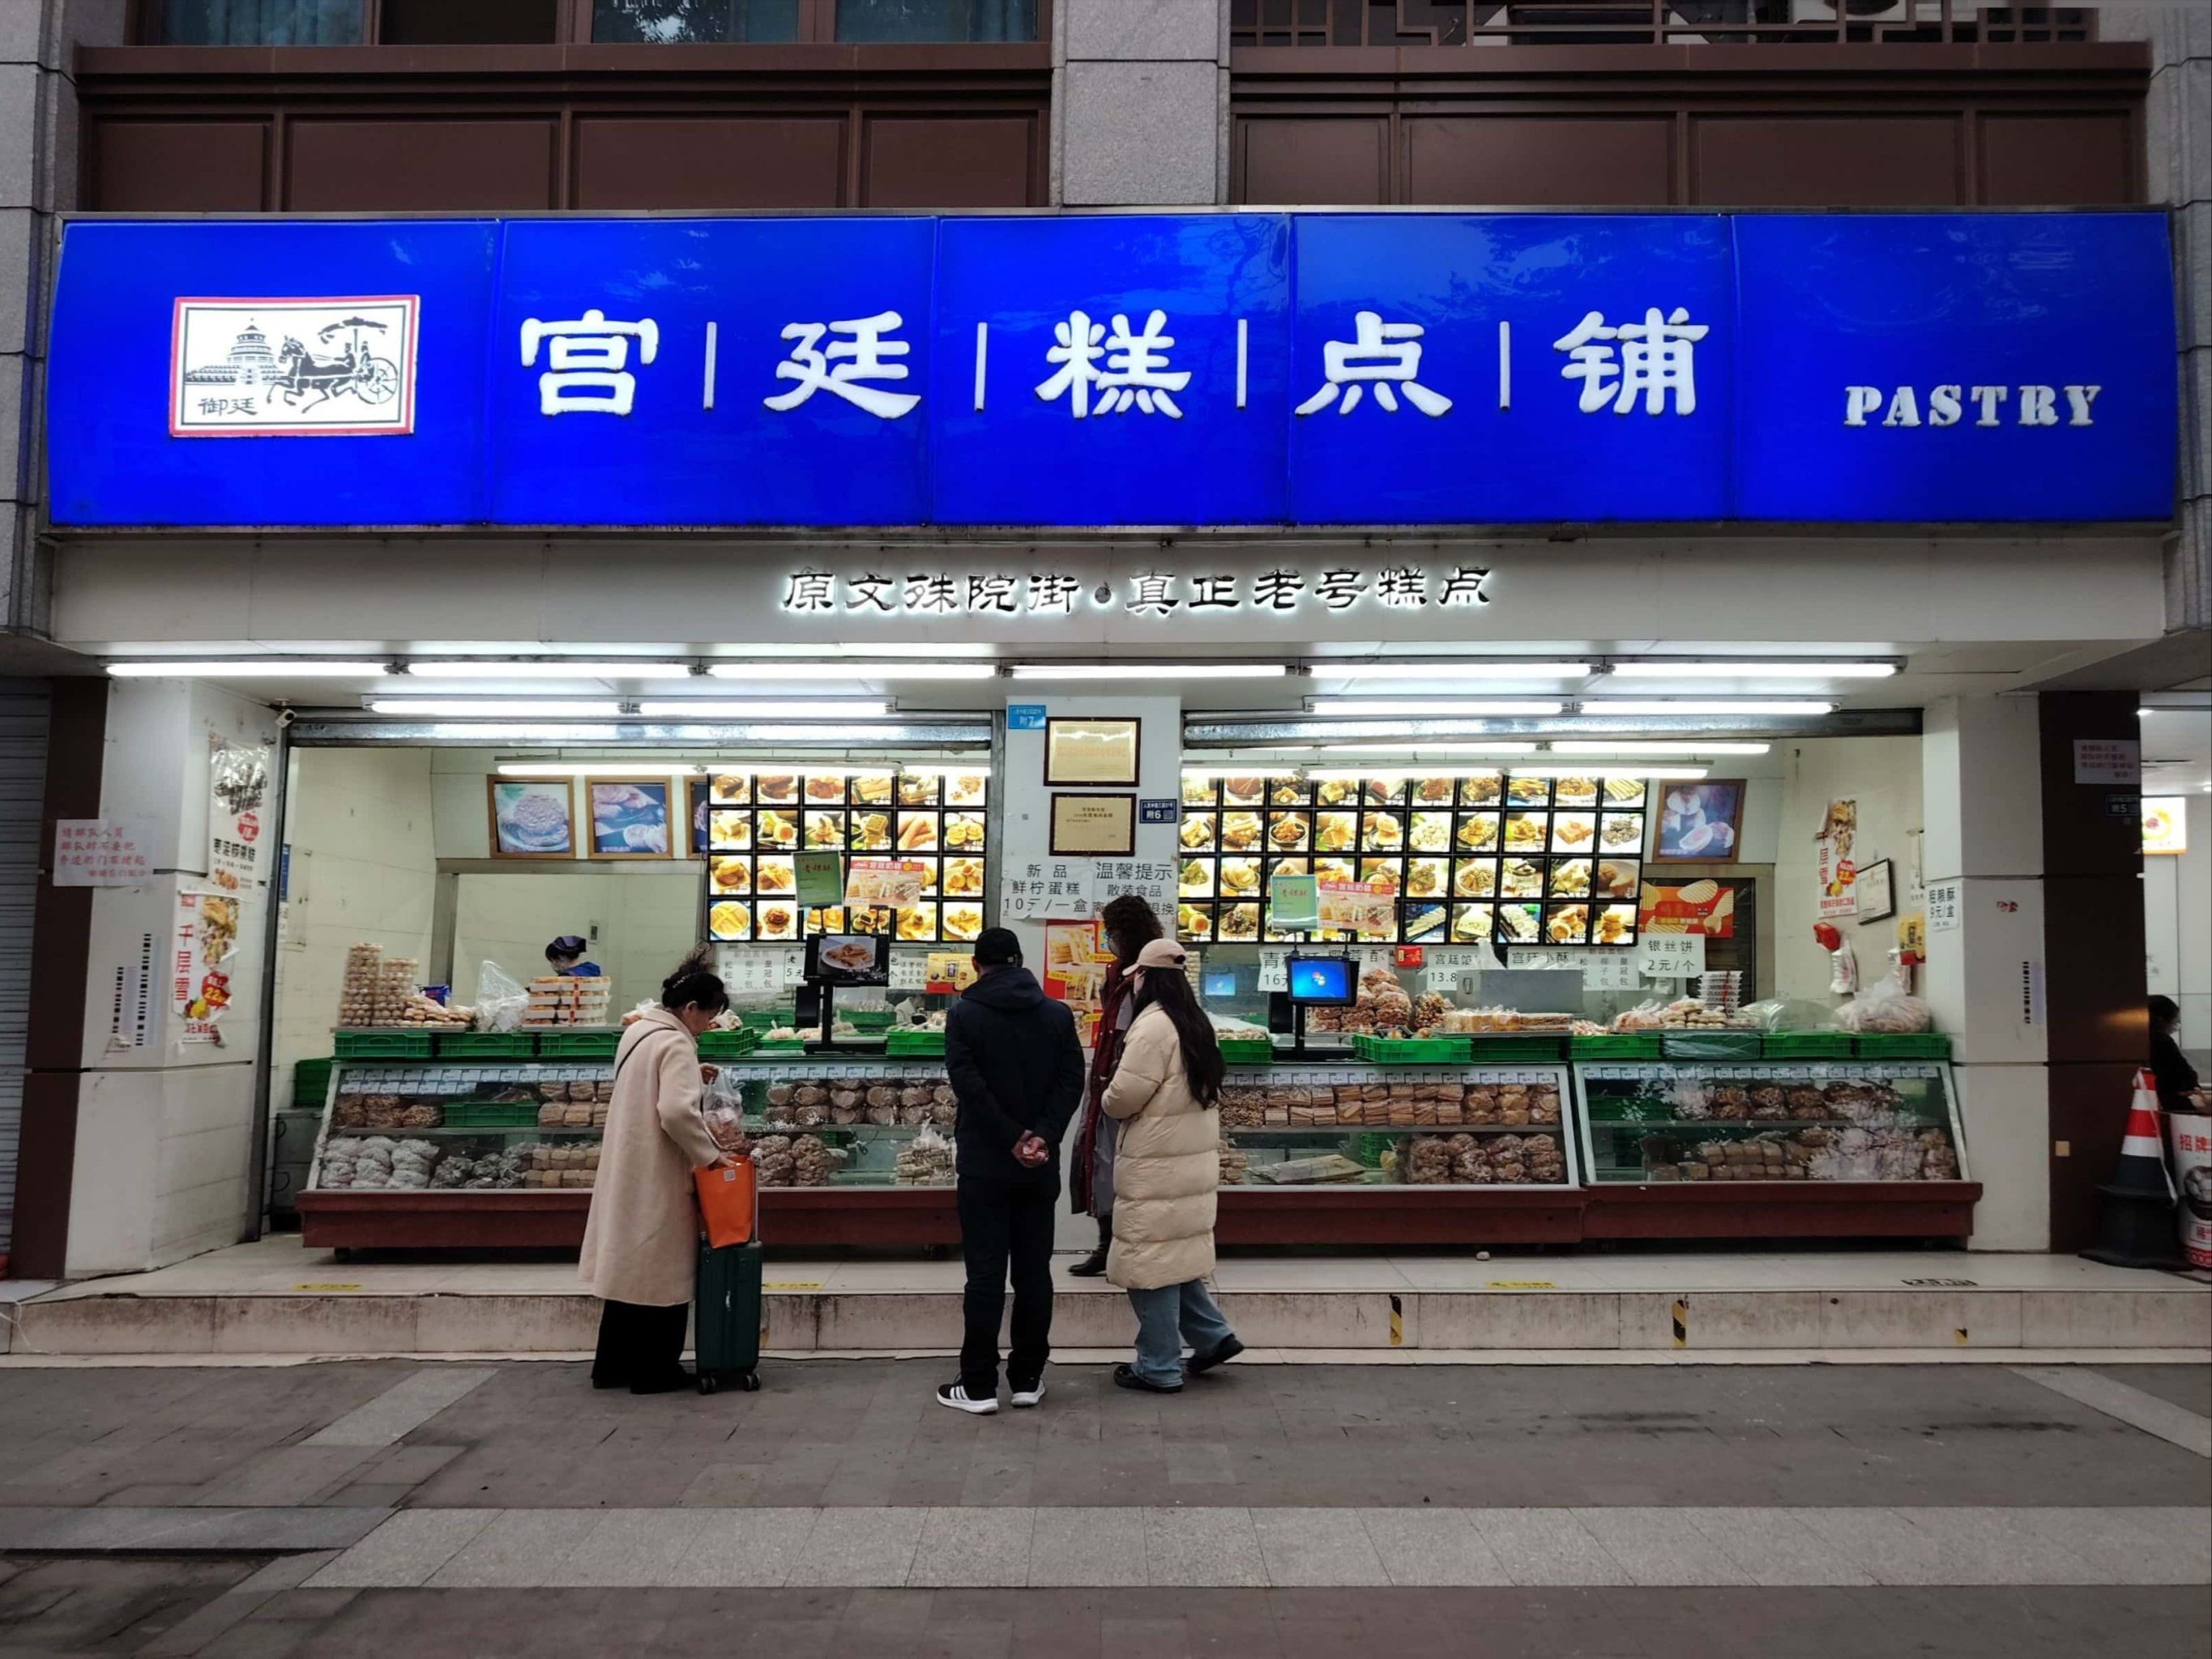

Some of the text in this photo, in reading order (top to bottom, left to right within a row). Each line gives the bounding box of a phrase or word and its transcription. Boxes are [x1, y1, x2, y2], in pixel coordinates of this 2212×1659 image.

[197, 397, 258, 417] 御廷
[1844, 384, 2103, 428] PASTRY
[1096, 862, 1172, 881] 温馨提示
[1011, 881, 1081, 895] 鲜柠蛋糕
[1107, 884, 1162, 898] 散装食品
[1648, 940, 1694, 953] 银丝饼
[1647, 959, 1695, 972] 2元/个
